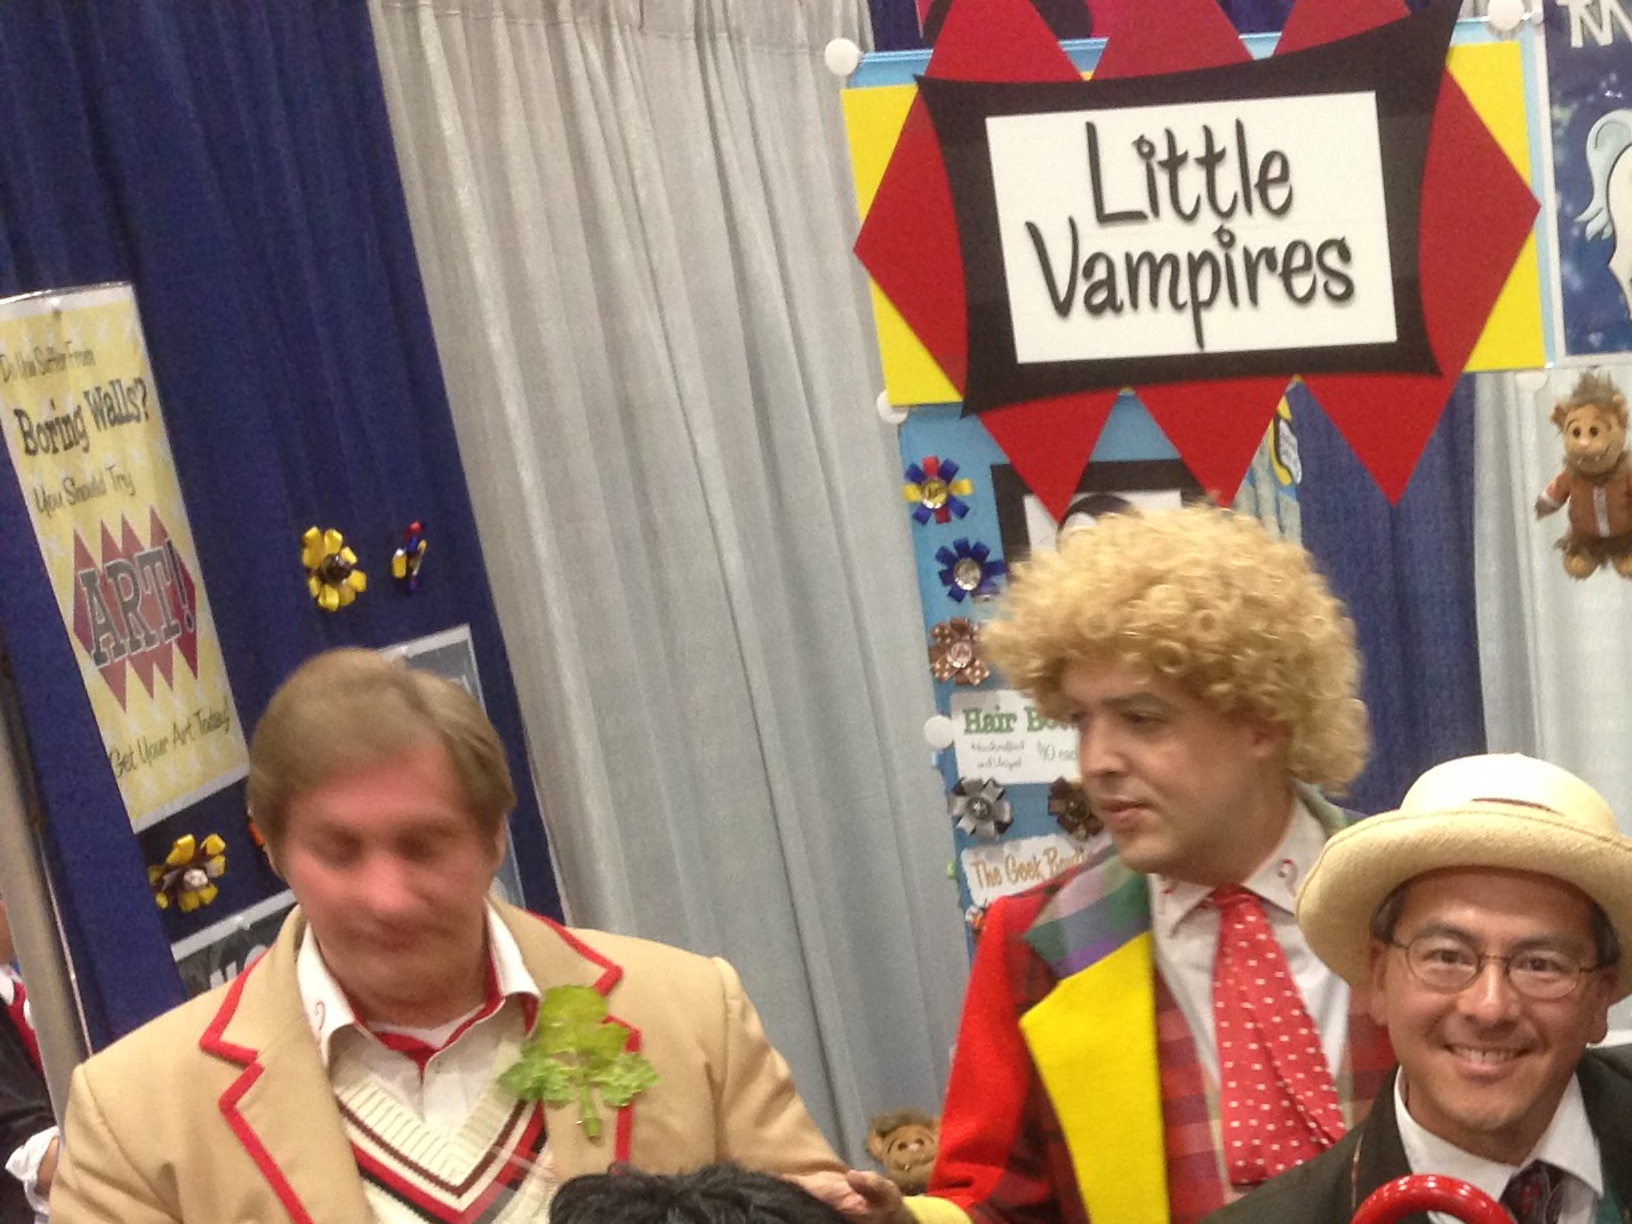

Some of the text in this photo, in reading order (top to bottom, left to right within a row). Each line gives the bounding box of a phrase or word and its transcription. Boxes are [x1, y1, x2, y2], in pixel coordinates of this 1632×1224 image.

[1086, 118, 1293, 225] Little
[1024, 216, 1355, 350] Vampires
[14, 377, 149, 456] Boring Walls?
[105, 464, 136, 496] Try
[79, 539, 195, 668] ART!
[110, 745, 137, 778] Get
[137, 735, 168, 767] Your
[173, 720, 193, 746] Art
[963, 705, 1018, 734] Hair
[970, 860, 1002, 889] The
[1005, 853, 1046, 885] Geek
